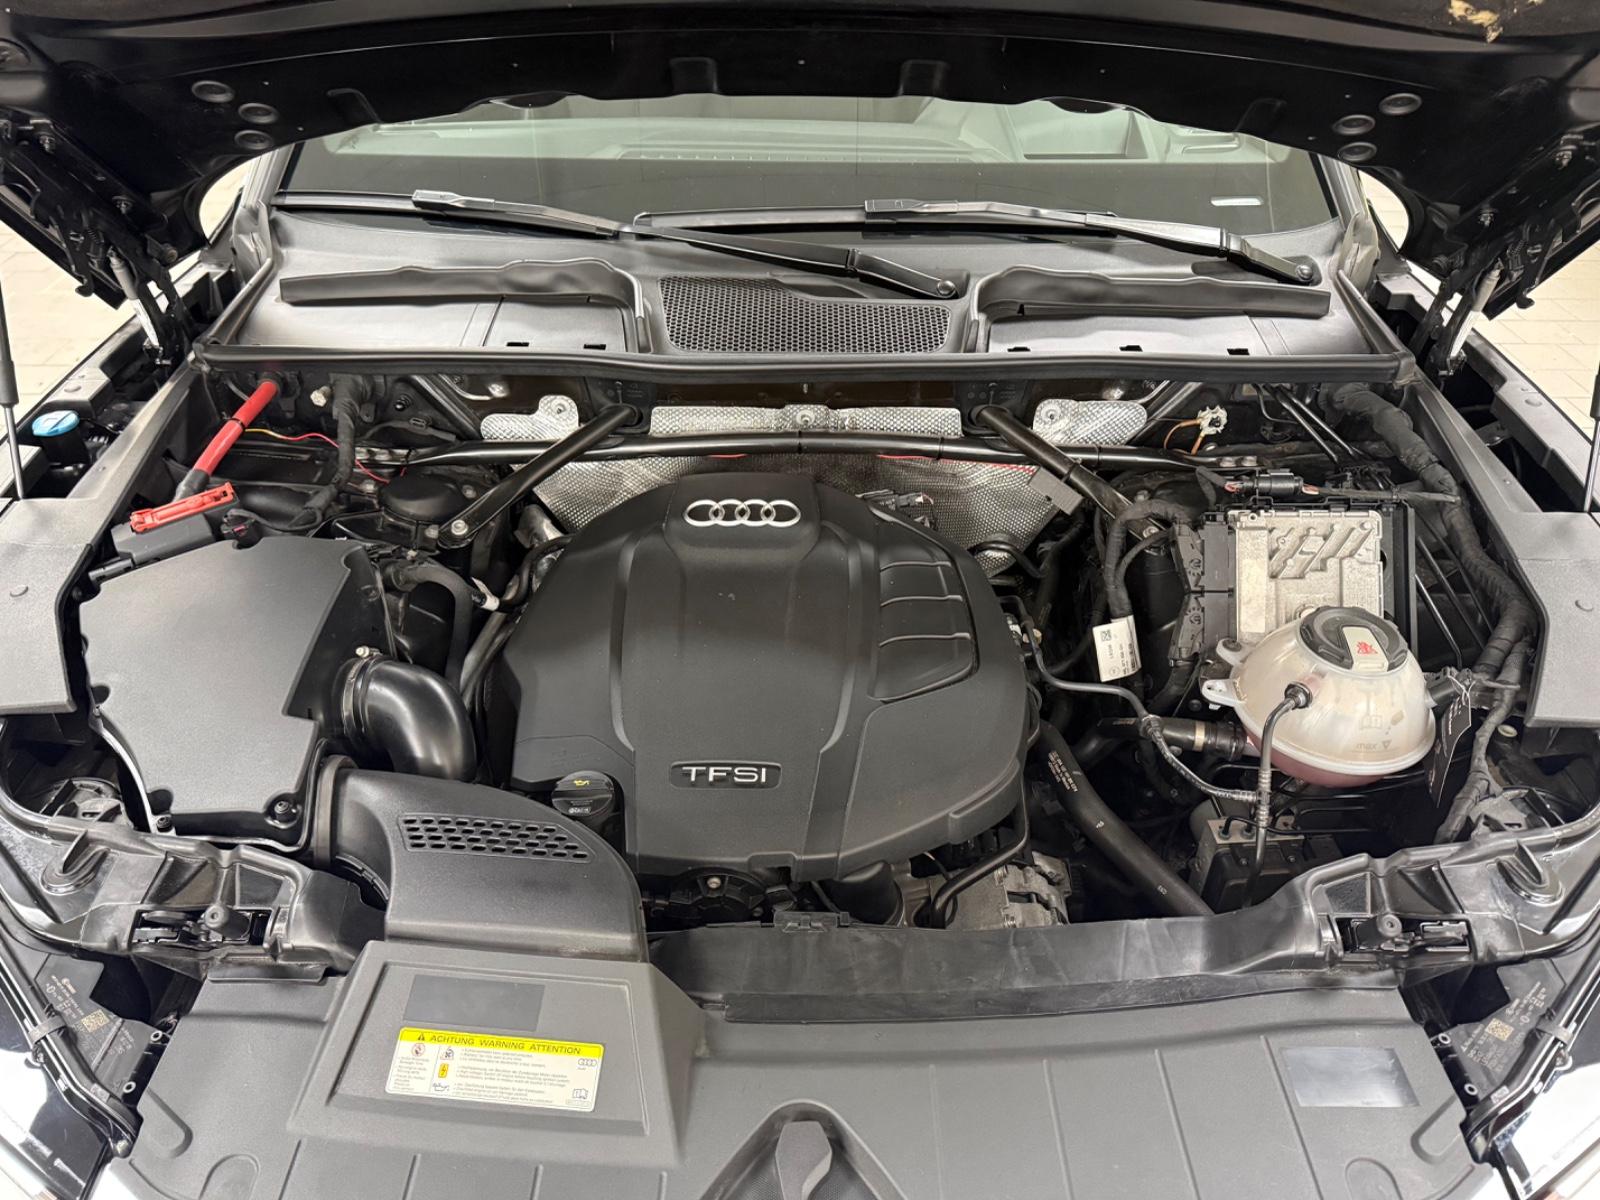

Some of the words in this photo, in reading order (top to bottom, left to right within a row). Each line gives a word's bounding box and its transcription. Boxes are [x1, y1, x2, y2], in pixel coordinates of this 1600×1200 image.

[681, 766, 767, 783] TFSI
[430, 1035, 475, 1046] ACHTUNG
[479, 1039, 525, 1050] WARNING
[529, 1044, 582, 1055] ATTENTION
